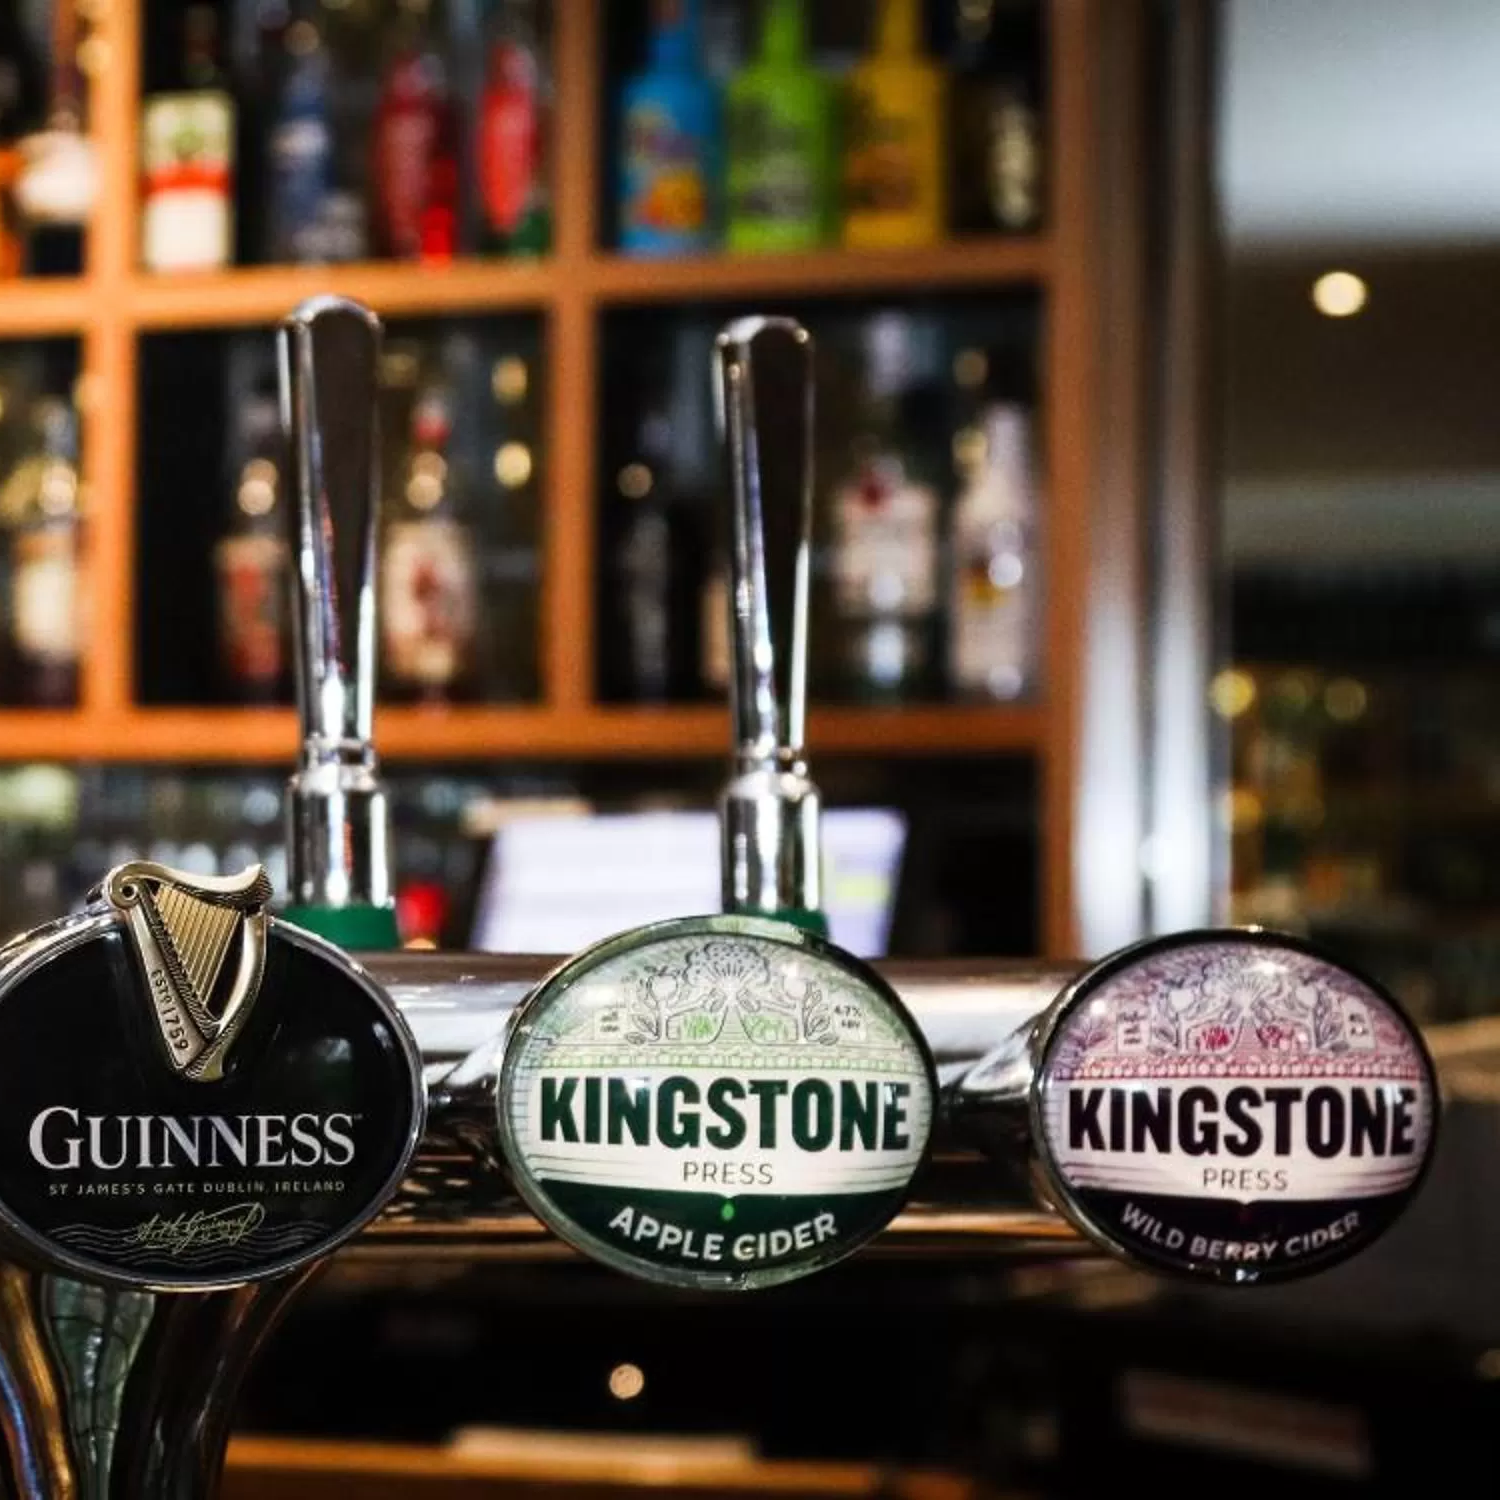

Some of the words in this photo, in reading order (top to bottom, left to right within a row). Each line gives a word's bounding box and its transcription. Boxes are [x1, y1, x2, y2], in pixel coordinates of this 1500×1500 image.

[161, 1007, 189, 1050] 1759
[28, 1105, 356, 1170] GUINNESS
[539, 1075, 911, 1153] KINGSTONE
[1067, 1085, 1417, 1159] KINGSTONE
[76, 1182, 146, 1196] JAMES'S
[153, 1181, 195, 1195] GATE
[274, 1179, 346, 1193] IRELAND
[683, 1160, 774, 1186] PRESS
[1202, 1167, 1289, 1192] PRESS
[608, 1205, 725, 1262] APPLE
[732, 1210, 839, 1262] CIDER
[1119, 1201, 1185, 1250] WILD
[1189, 1235, 1278, 1262] BERRY
[1284, 1209, 1361, 1258] CIDER
